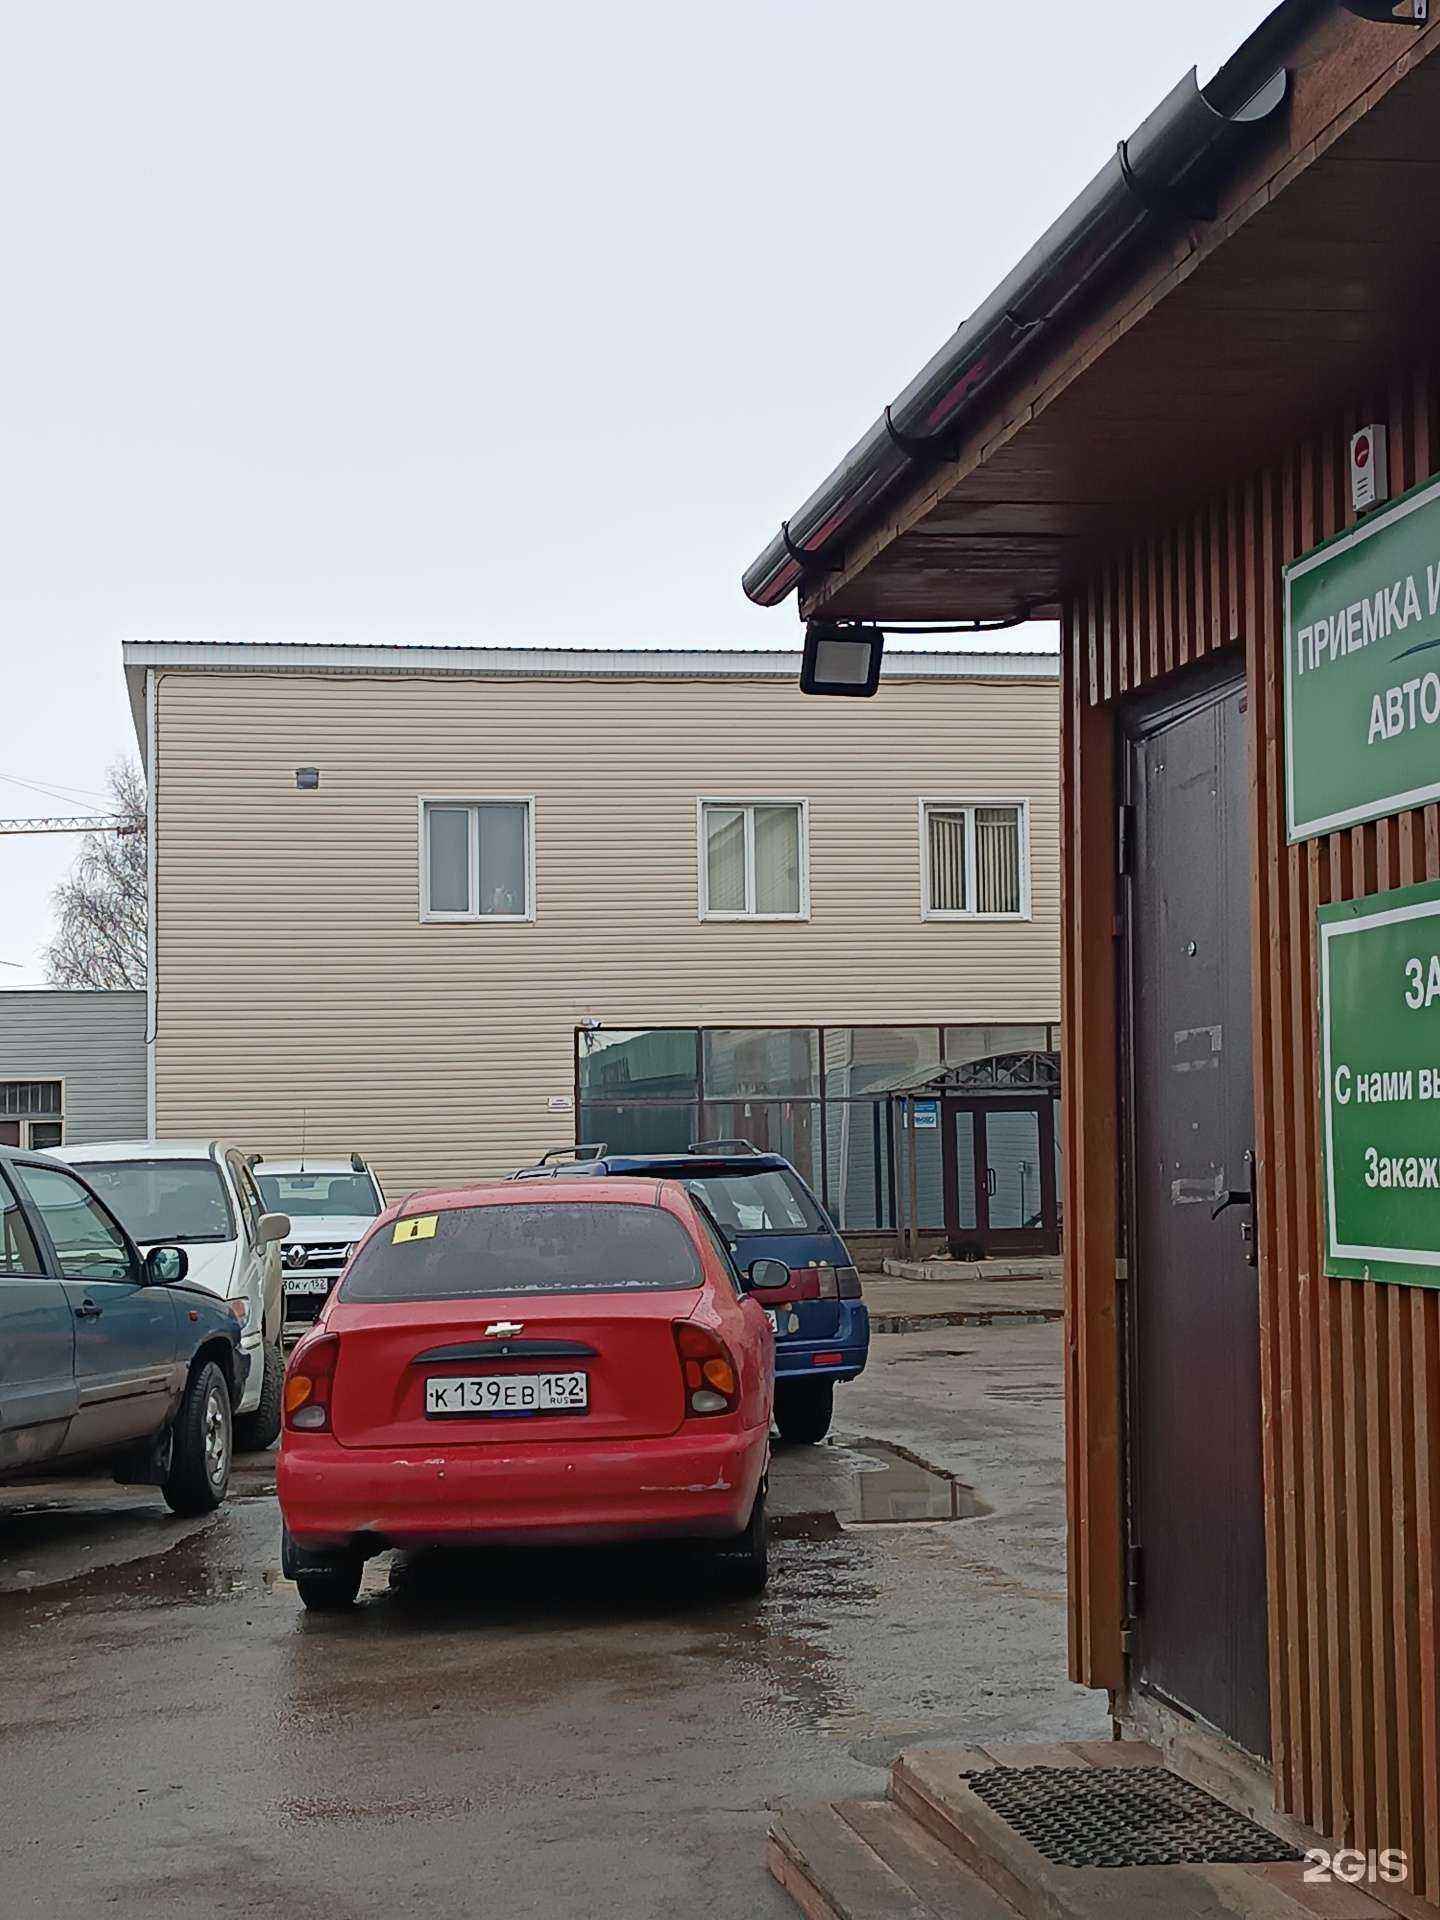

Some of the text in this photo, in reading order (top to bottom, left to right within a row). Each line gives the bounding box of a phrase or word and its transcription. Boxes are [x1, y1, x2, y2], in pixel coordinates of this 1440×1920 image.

[1298, 575, 1422, 675] ПРИЕМКА
[1368, 672, 1440, 744] АВТО
[1335, 1065, 1350, 1104] С
[1357, 1070, 1412, 1103] нами
[1365, 1147, 1440, 1188] Закаж
[542, 1377, 579, 1396] 152
[550, 1396, 569, 1405] RUS
